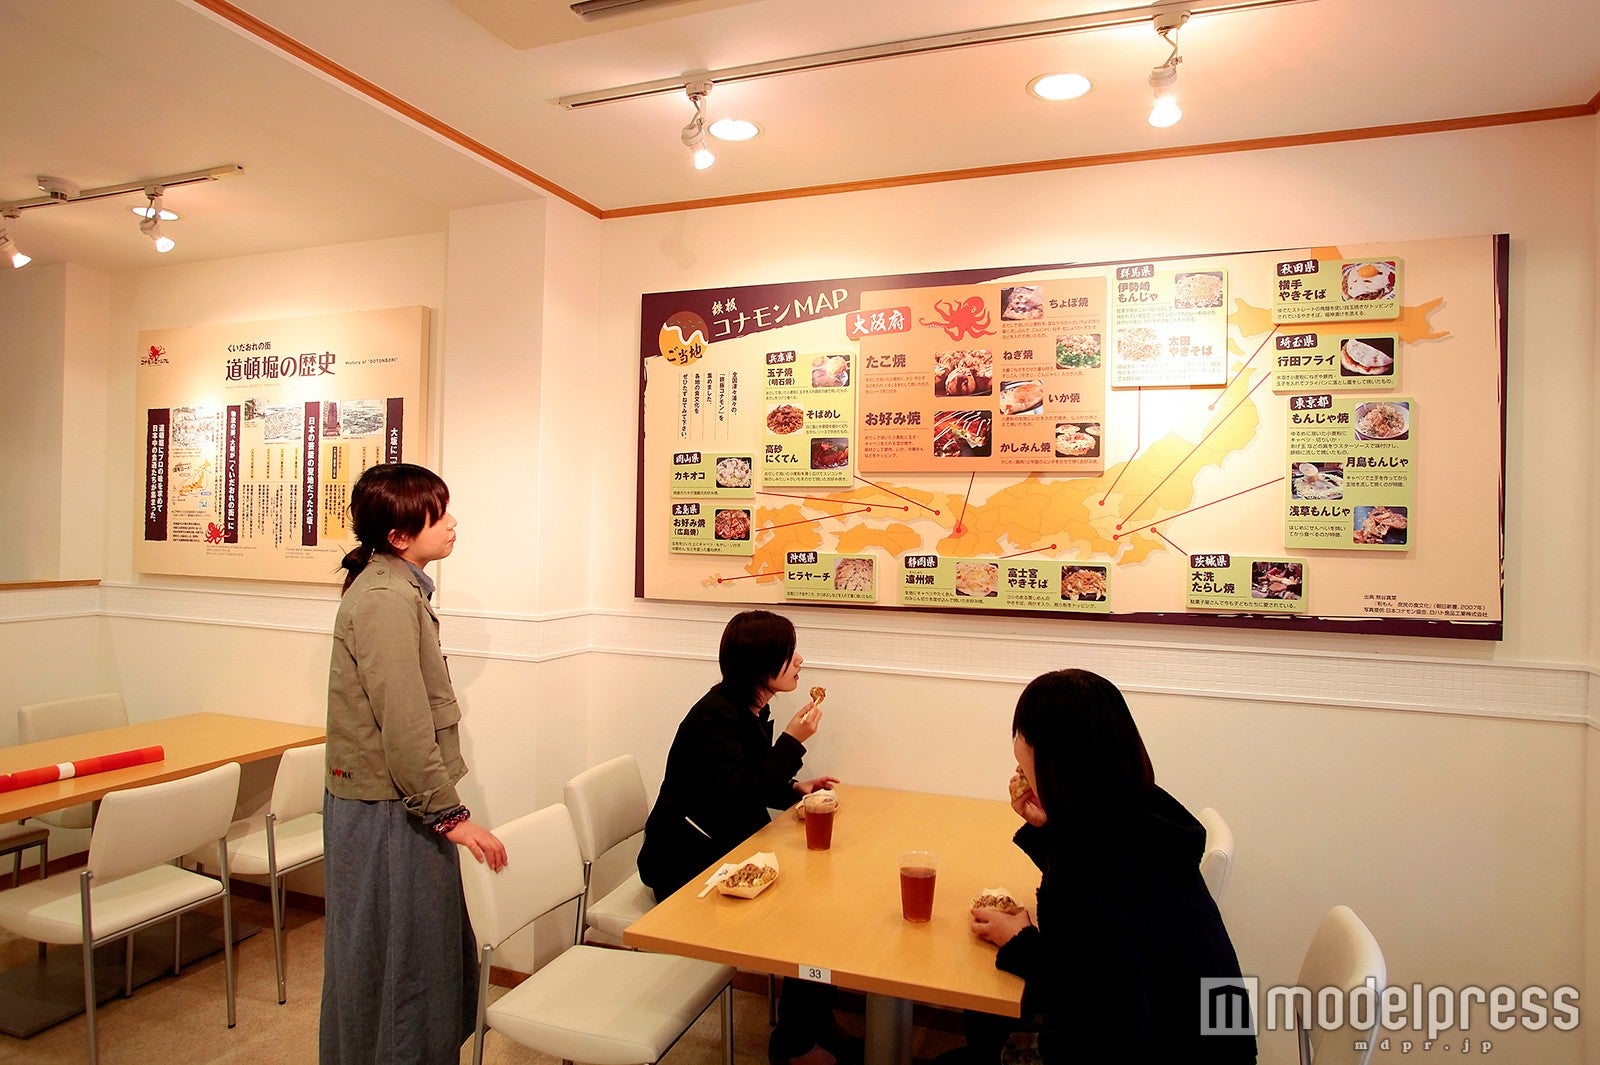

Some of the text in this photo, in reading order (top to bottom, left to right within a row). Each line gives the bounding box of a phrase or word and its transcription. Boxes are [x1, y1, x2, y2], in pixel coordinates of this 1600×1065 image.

[1120, 266, 1150, 278] 群馬県
[1281, 261, 1316, 275] 秋田県
[1118, 282, 1150, 293] 伊勢崎
[1278, 279, 1302, 290] 横手
[1118, 293, 1158, 303] もんじゃ
[1278, 290, 1326, 301] やきそば
[711, 297, 737, 316] 鉄板
[1050, 298, 1088, 308] ちょぼ焼
[713, 288, 849, 337] コナモンMAP
[852, 310, 904, 334] 大阪府
[1168, 336, 1190, 346] 太田
[1280, 335, 1314, 348] 埼玉県
[228, 342, 272, 352] くいだおれの街
[1168, 346, 1212, 356] やきそば
[666, 343, 702, 365] ご当地
[769, 352, 794, 364] 兵庫県
[1003, 350, 1033, 360] ねぎ焼
[866, 354, 906, 368] たこ焼
[1278, 355, 1336, 366] 行田フライ
[226, 352, 336, 381] 道頓堀の歴史
[767, 368, 792, 378] 玉子焼
[1048, 392, 1080, 402] いか焼
[1294, 396, 1330, 409] 東京都
[806, 410, 840, 419] そばめし
[865, 412, 921, 426] お好み焼
[1292, 412, 1349, 424] もんじゃ焼
[766, 444, 783, 454] 高砂
[1000, 442, 1050, 452] かしみん焼
[676, 453, 699, 464] 岡山県
[766, 454, 798, 463] にくてん
[1346, 456, 1408, 468] 月島もんじゃ
[674, 472, 706, 480] カキオコ
[674, 504, 697, 514] 広島県
[1289, 506, 1350, 517] 浅草もんじゃ
[673, 518, 706, 528] お好み焼
[790, 552, 815, 563] 沖縄県
[908, 556, 936, 568] 静岡県
[1194, 555, 1228, 568] 茨城県
[788, 572, 830, 581] ヒラヤーチ
[1008, 568, 1038, 578] 富士宮
[1192, 571, 1214, 582] 大洗
[906, 574, 934, 584] 遠州焼
[1008, 578, 1048, 588] やきそば
[1192, 582, 1234, 594] たらし焼
[809, 968, 822, 979] 33
